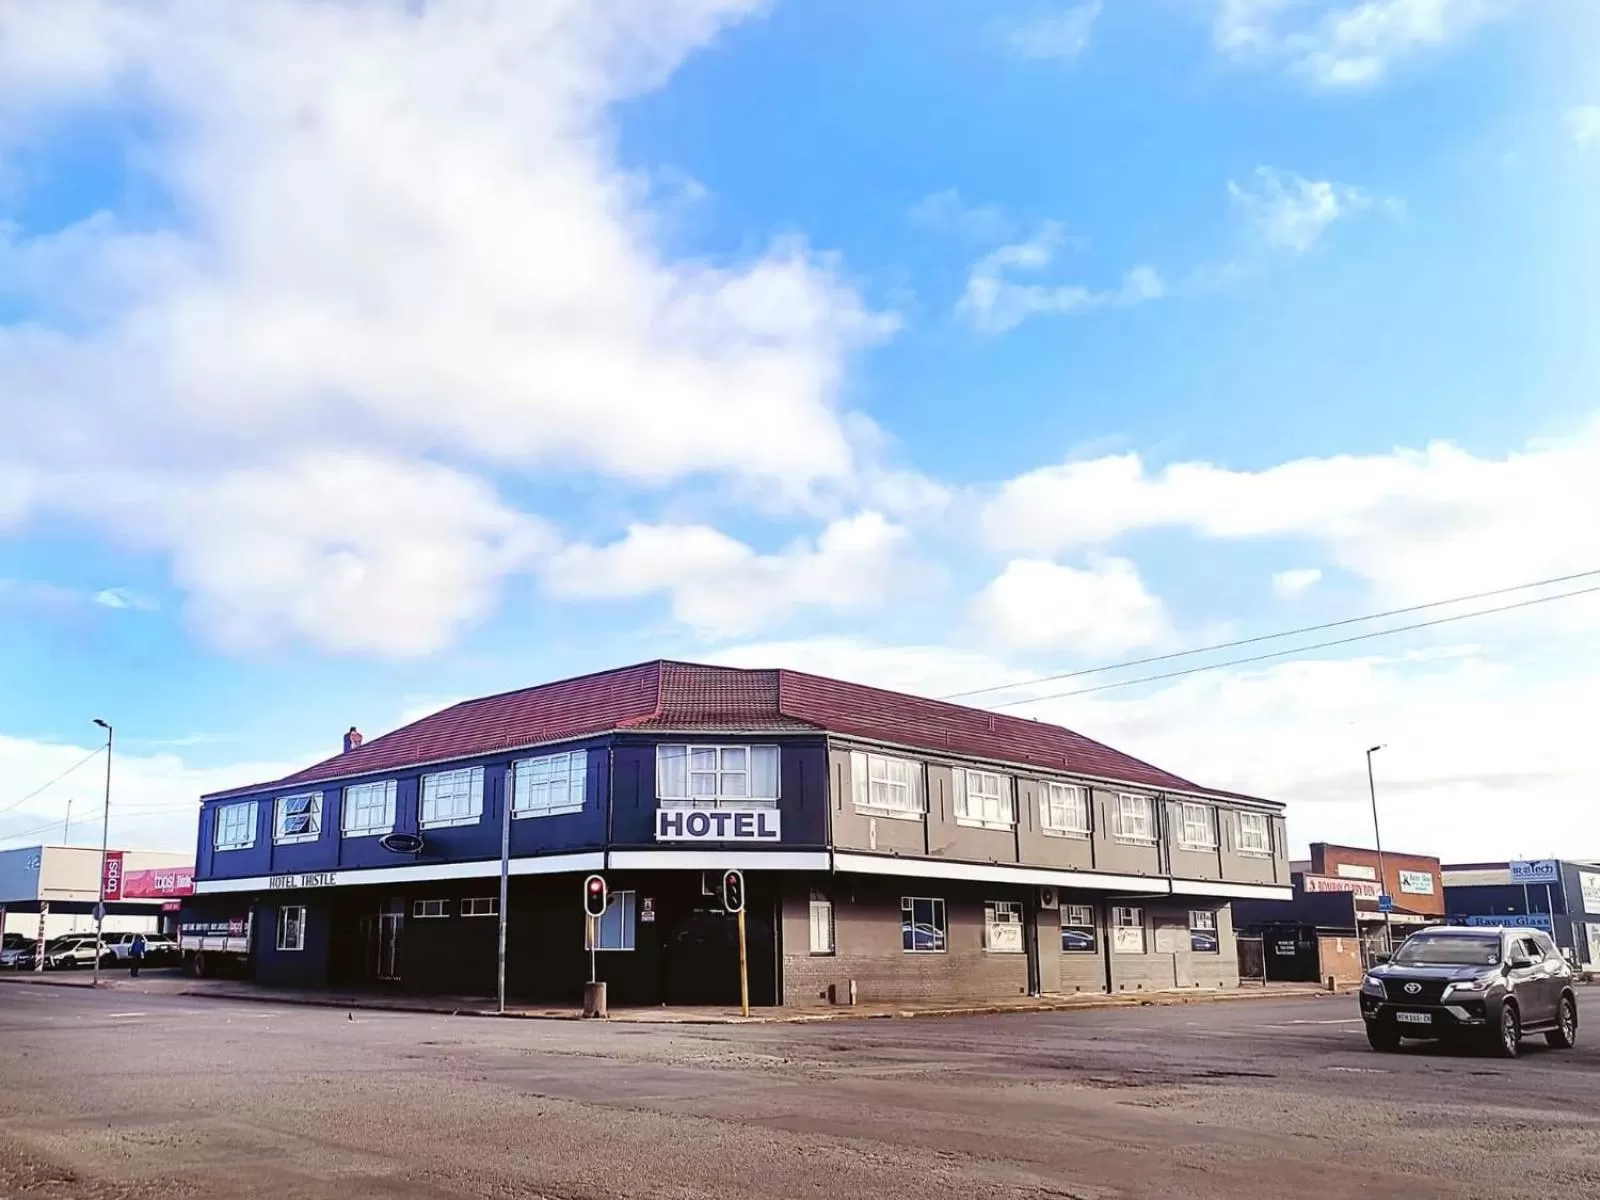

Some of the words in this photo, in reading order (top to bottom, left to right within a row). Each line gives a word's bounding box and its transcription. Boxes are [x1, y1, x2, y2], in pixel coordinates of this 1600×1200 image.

[660, 812, 777, 837] HOTEL
[269, 876, 298, 889] HOTEL
[301, 873, 337, 886] THISTLE
[1475, 917, 1511, 926] Raven
[1516, 916, 1550, 926] Glass
